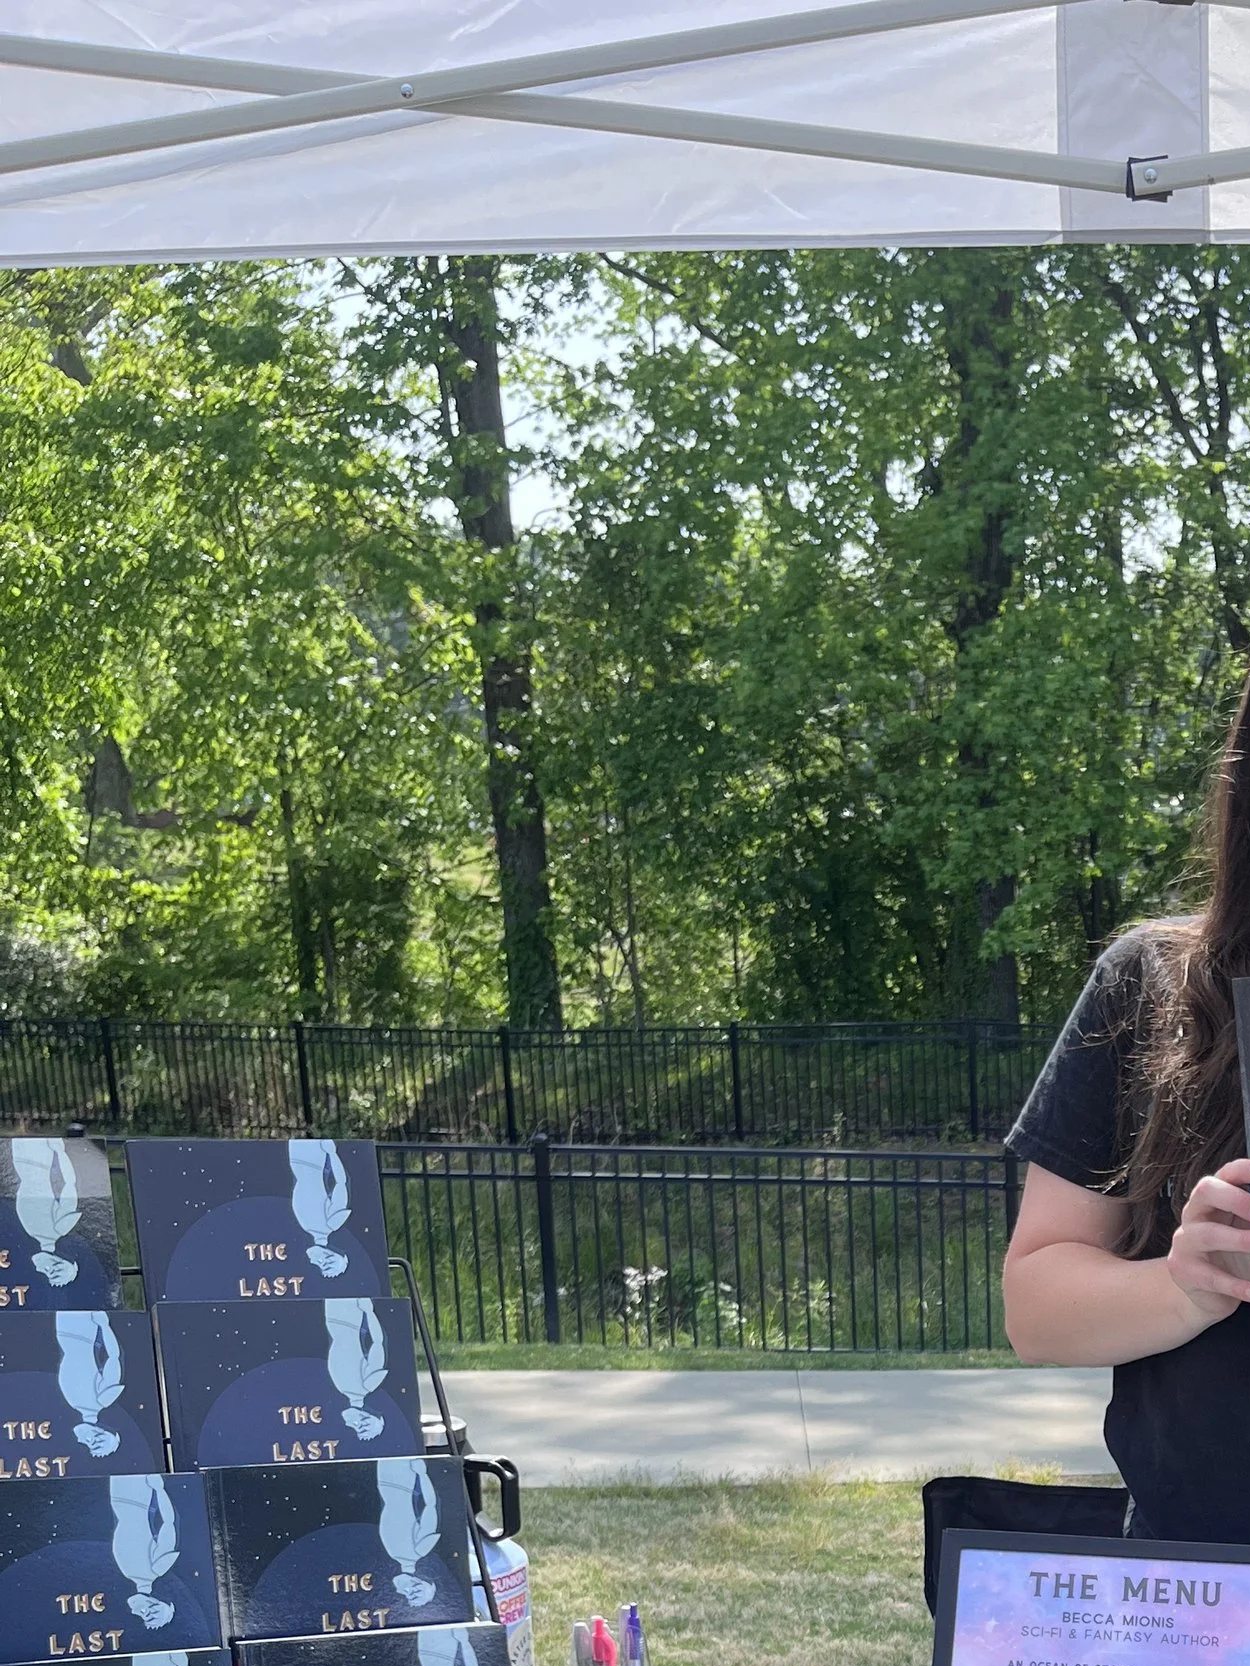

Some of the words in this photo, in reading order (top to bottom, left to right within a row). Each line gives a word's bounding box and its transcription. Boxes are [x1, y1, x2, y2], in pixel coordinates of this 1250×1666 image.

[244, 1243, 287, 1261] THE
[0, 1286, 29, 1308] ST
[239, 1277, 304, 1297] LAST
[278, 1406, 323, 1424] THE
[3, 1421, 52, 1440] THE
[272, 1440, 338, 1461] LAST
[329, 1573, 373, 1592] THE
[1029, 1572, 1098, 1600] THE
[1121, 1577, 1222, 1606] MENU
[56, 1593, 105, 1614] THE
[322, 1608, 390, 1632] LAST
[1062, 1612, 1114, 1625] BECCA
[1122, 1615, 1174, 1628] MIONIS
[49, 1630, 124, 1655] LAST
[1021, 1626, 1062, 1638] SCI-FI
[1068, 1629, 1077, 1639] &
[1085, 1630, 1153, 1642] FANTASY
[1161, 1634, 1220, 1647] AUTHOR
